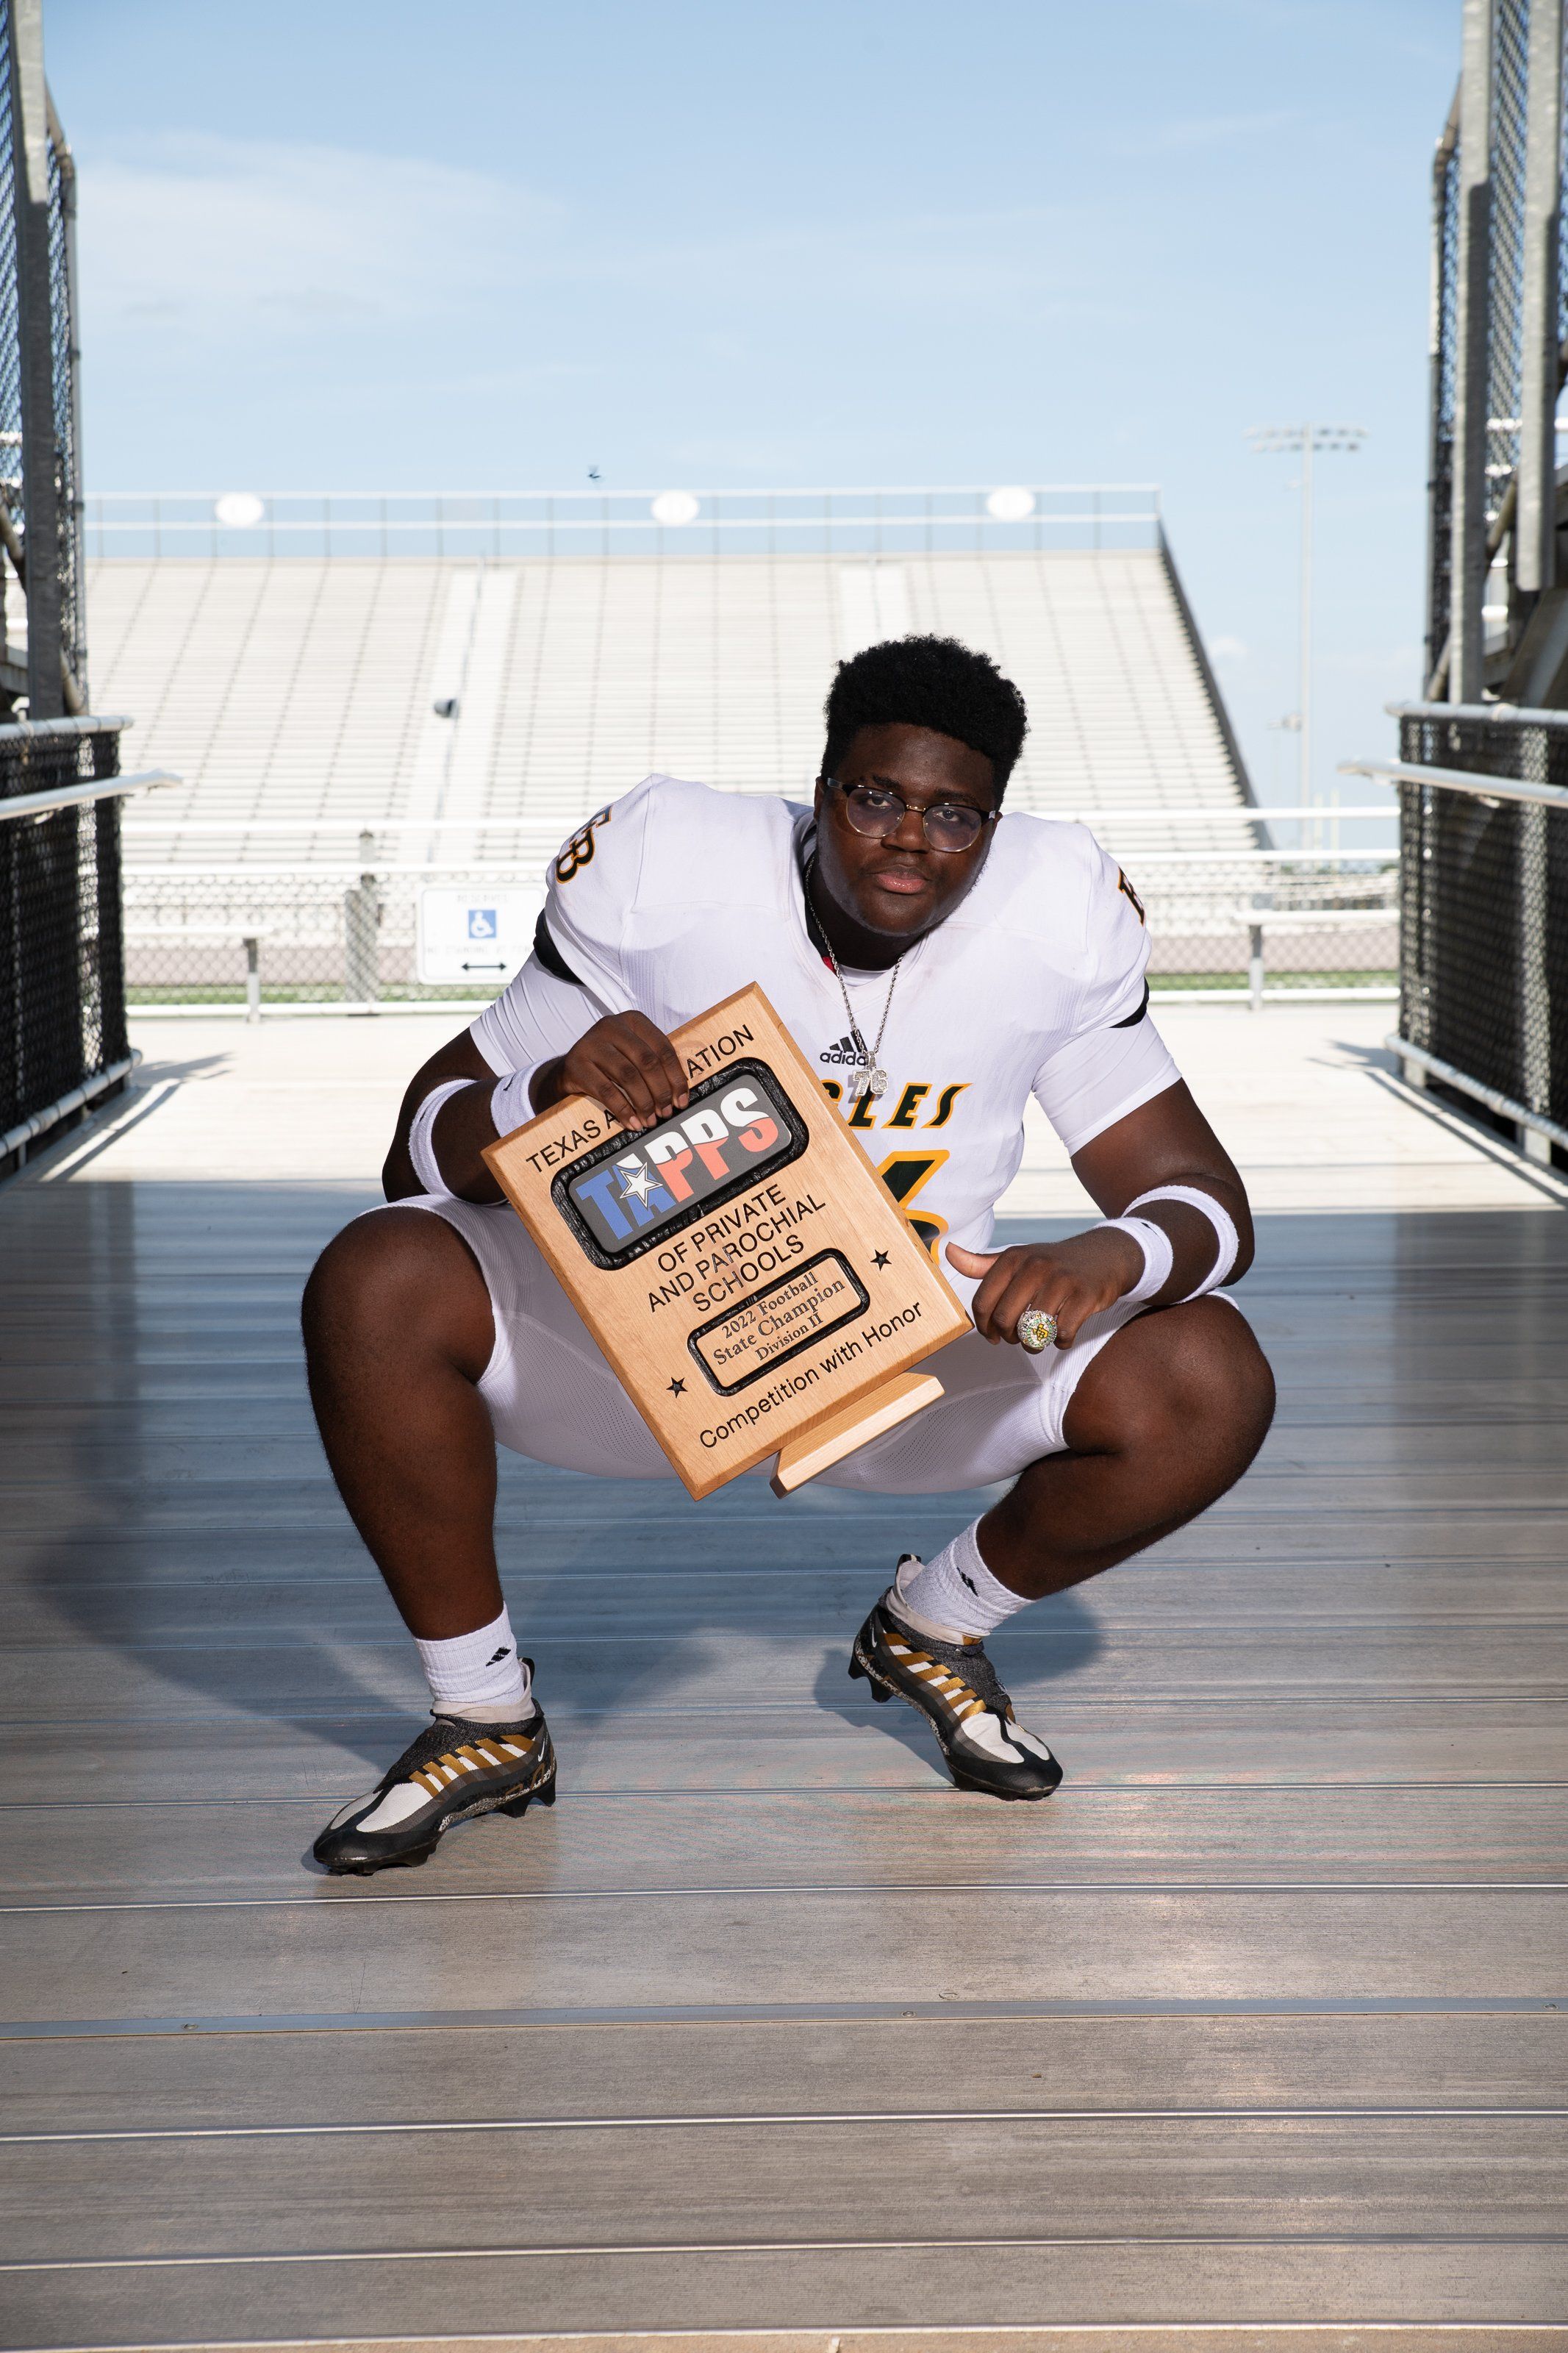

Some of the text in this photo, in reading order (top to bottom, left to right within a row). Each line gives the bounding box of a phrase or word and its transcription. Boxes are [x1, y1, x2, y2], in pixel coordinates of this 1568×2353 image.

[820, 1050, 867, 1066] adida
[853, 1068, 889, 1096] 76
[821, 1079, 973, 1129] LES
[526, 1119, 602, 1174] TEXAS
[575, 1086, 779, 1240] TAPPS
[647, 1271, 694, 1313] AND
[698, 1194, 826, 1281] PAROCHIAL
[658, 1184, 786, 1273] OF PRIVATE
[693, 1234, 804, 1313] SCHOOLS
[721, 1271, 818, 1339] 2022 Football
[712, 1277, 846, 1366] State Champion
[754, 1311, 825, 1361] Division II
[699, 1302, 923, 1449] Competition with Honor
